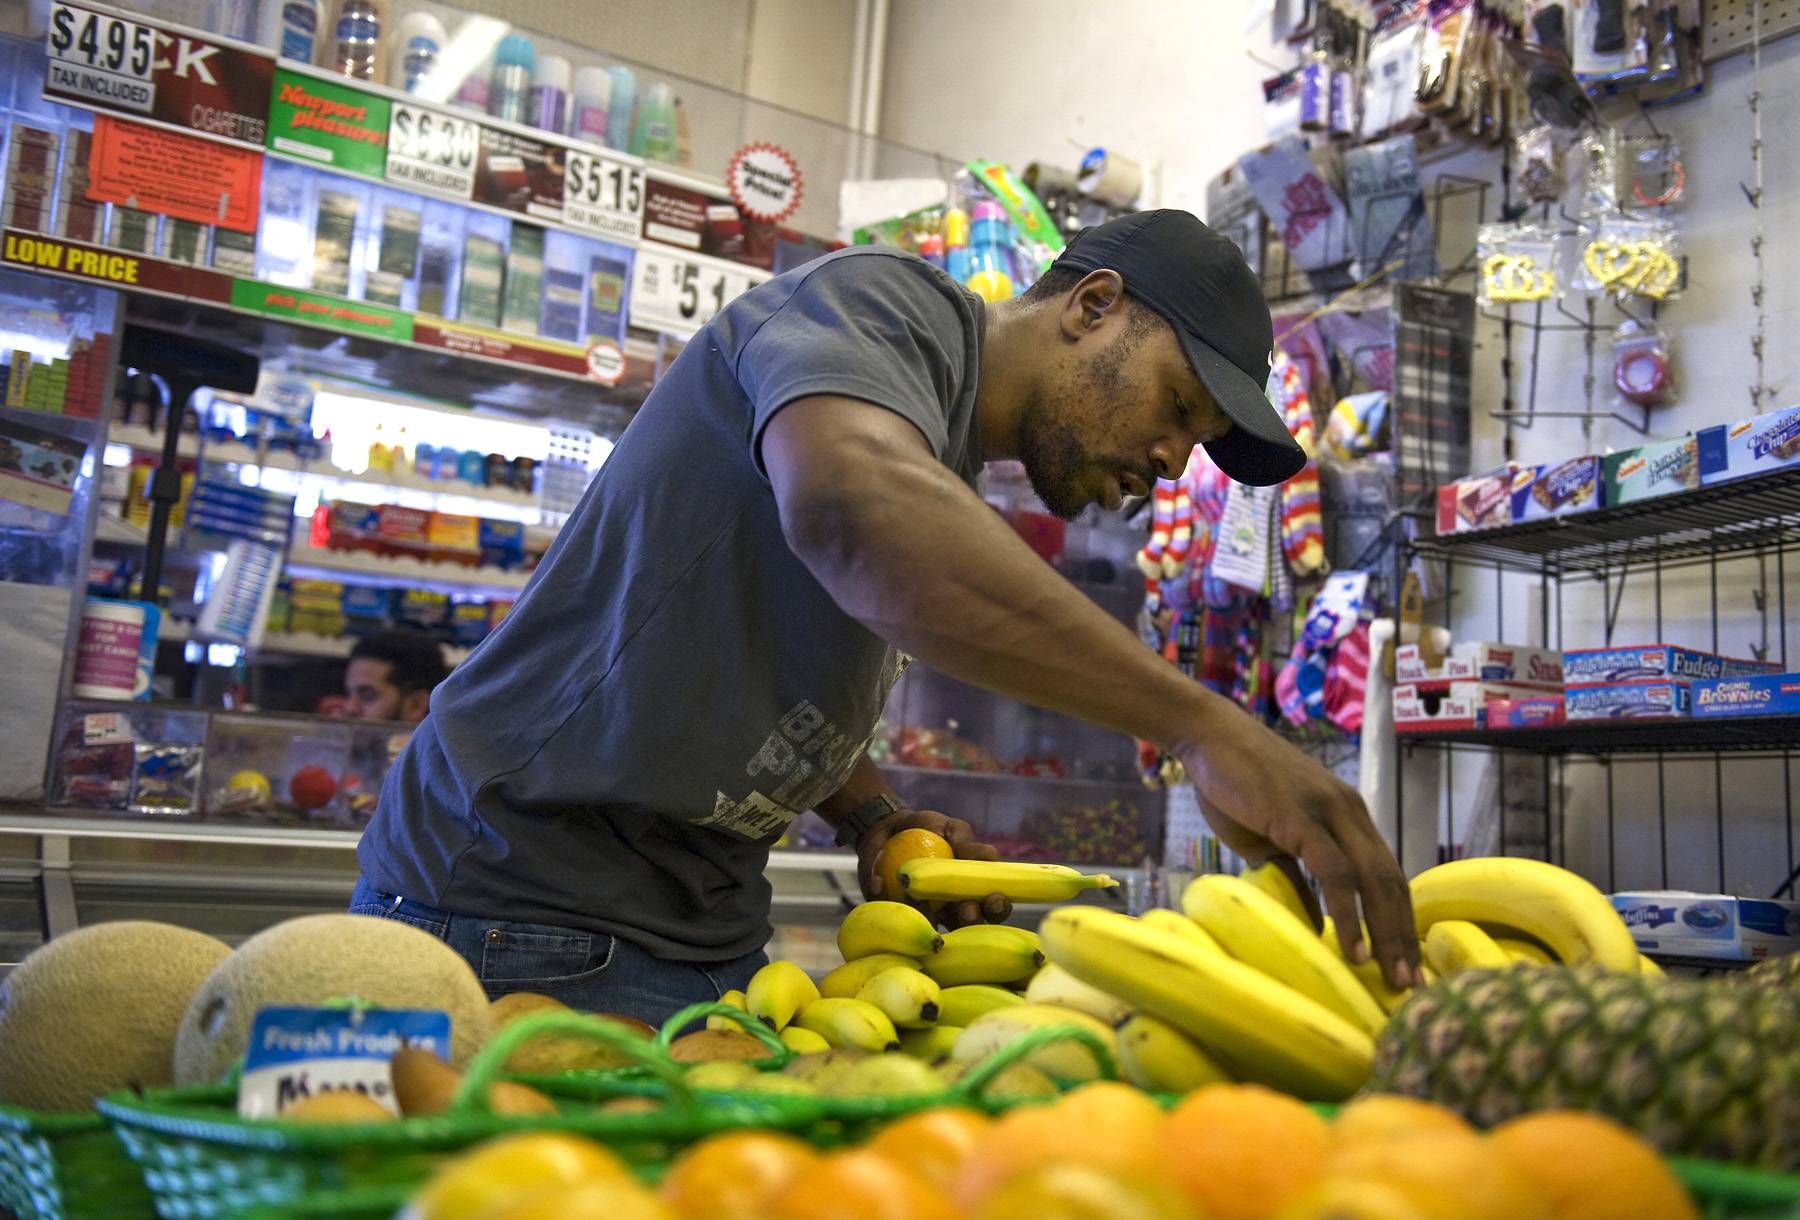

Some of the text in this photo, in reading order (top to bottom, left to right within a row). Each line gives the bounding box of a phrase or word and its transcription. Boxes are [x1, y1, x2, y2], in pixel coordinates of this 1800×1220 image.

[51, 6, 150, 77] $4.95
[51, 66, 150, 105] TAX INCLUDED
[278, 83, 368, 123] Newport
[5, 235, 138, 284] LOW PRICE
[1759, 431, 1788, 455] Chip
[1528, 653, 1563, 682] Sna
[1672, 652, 1720, 679] Fudge
[262, 1026, 333, 1052] Fresh
